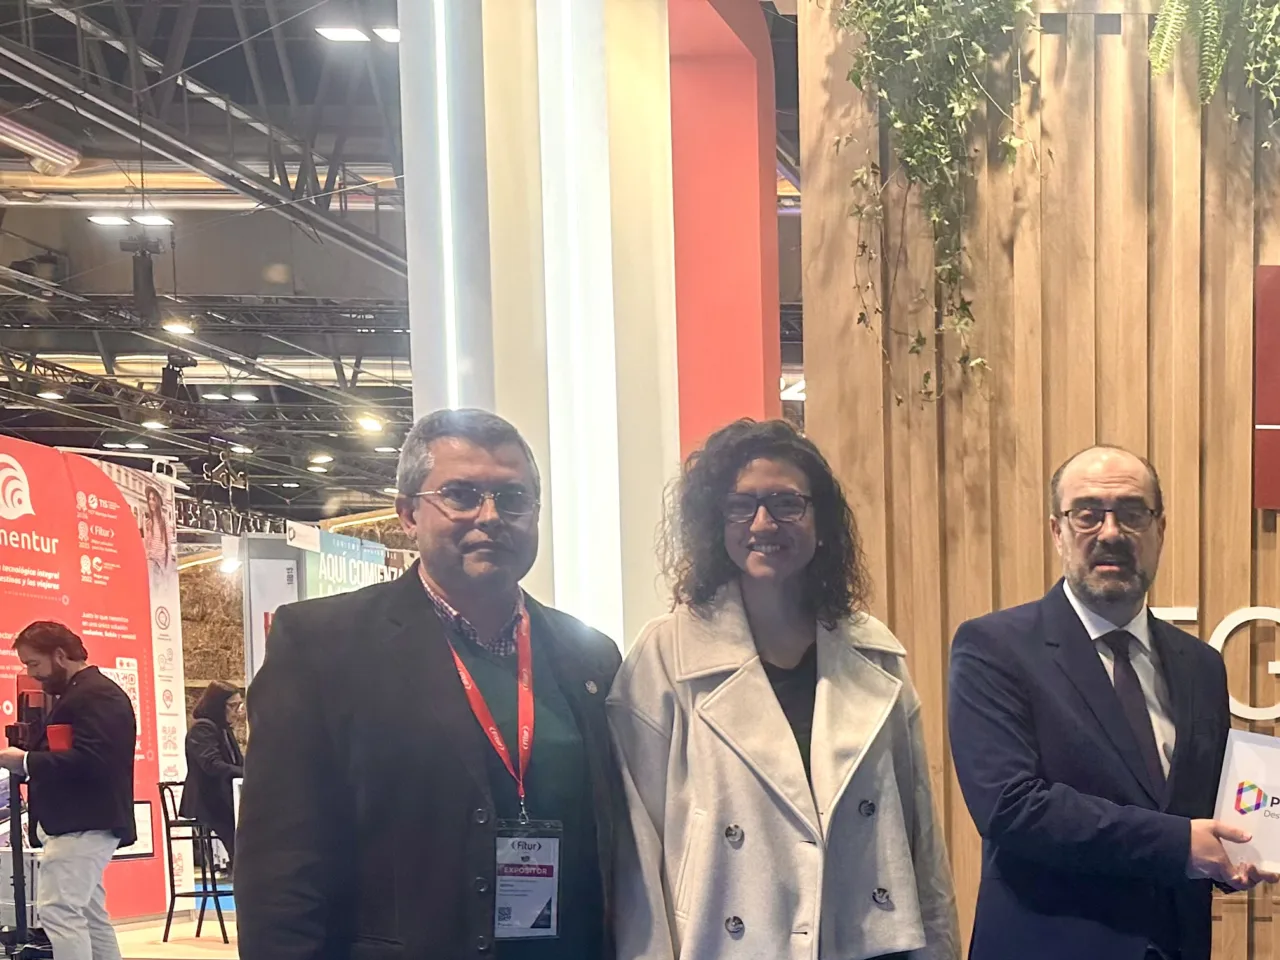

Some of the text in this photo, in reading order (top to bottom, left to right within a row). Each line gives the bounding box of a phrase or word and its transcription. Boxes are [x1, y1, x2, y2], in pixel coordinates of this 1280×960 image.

[319, 551, 347, 584] AQUÍ
[0, 574, 21, 585] estinos
[503, 866, 548, 875] EXPOSITOR
